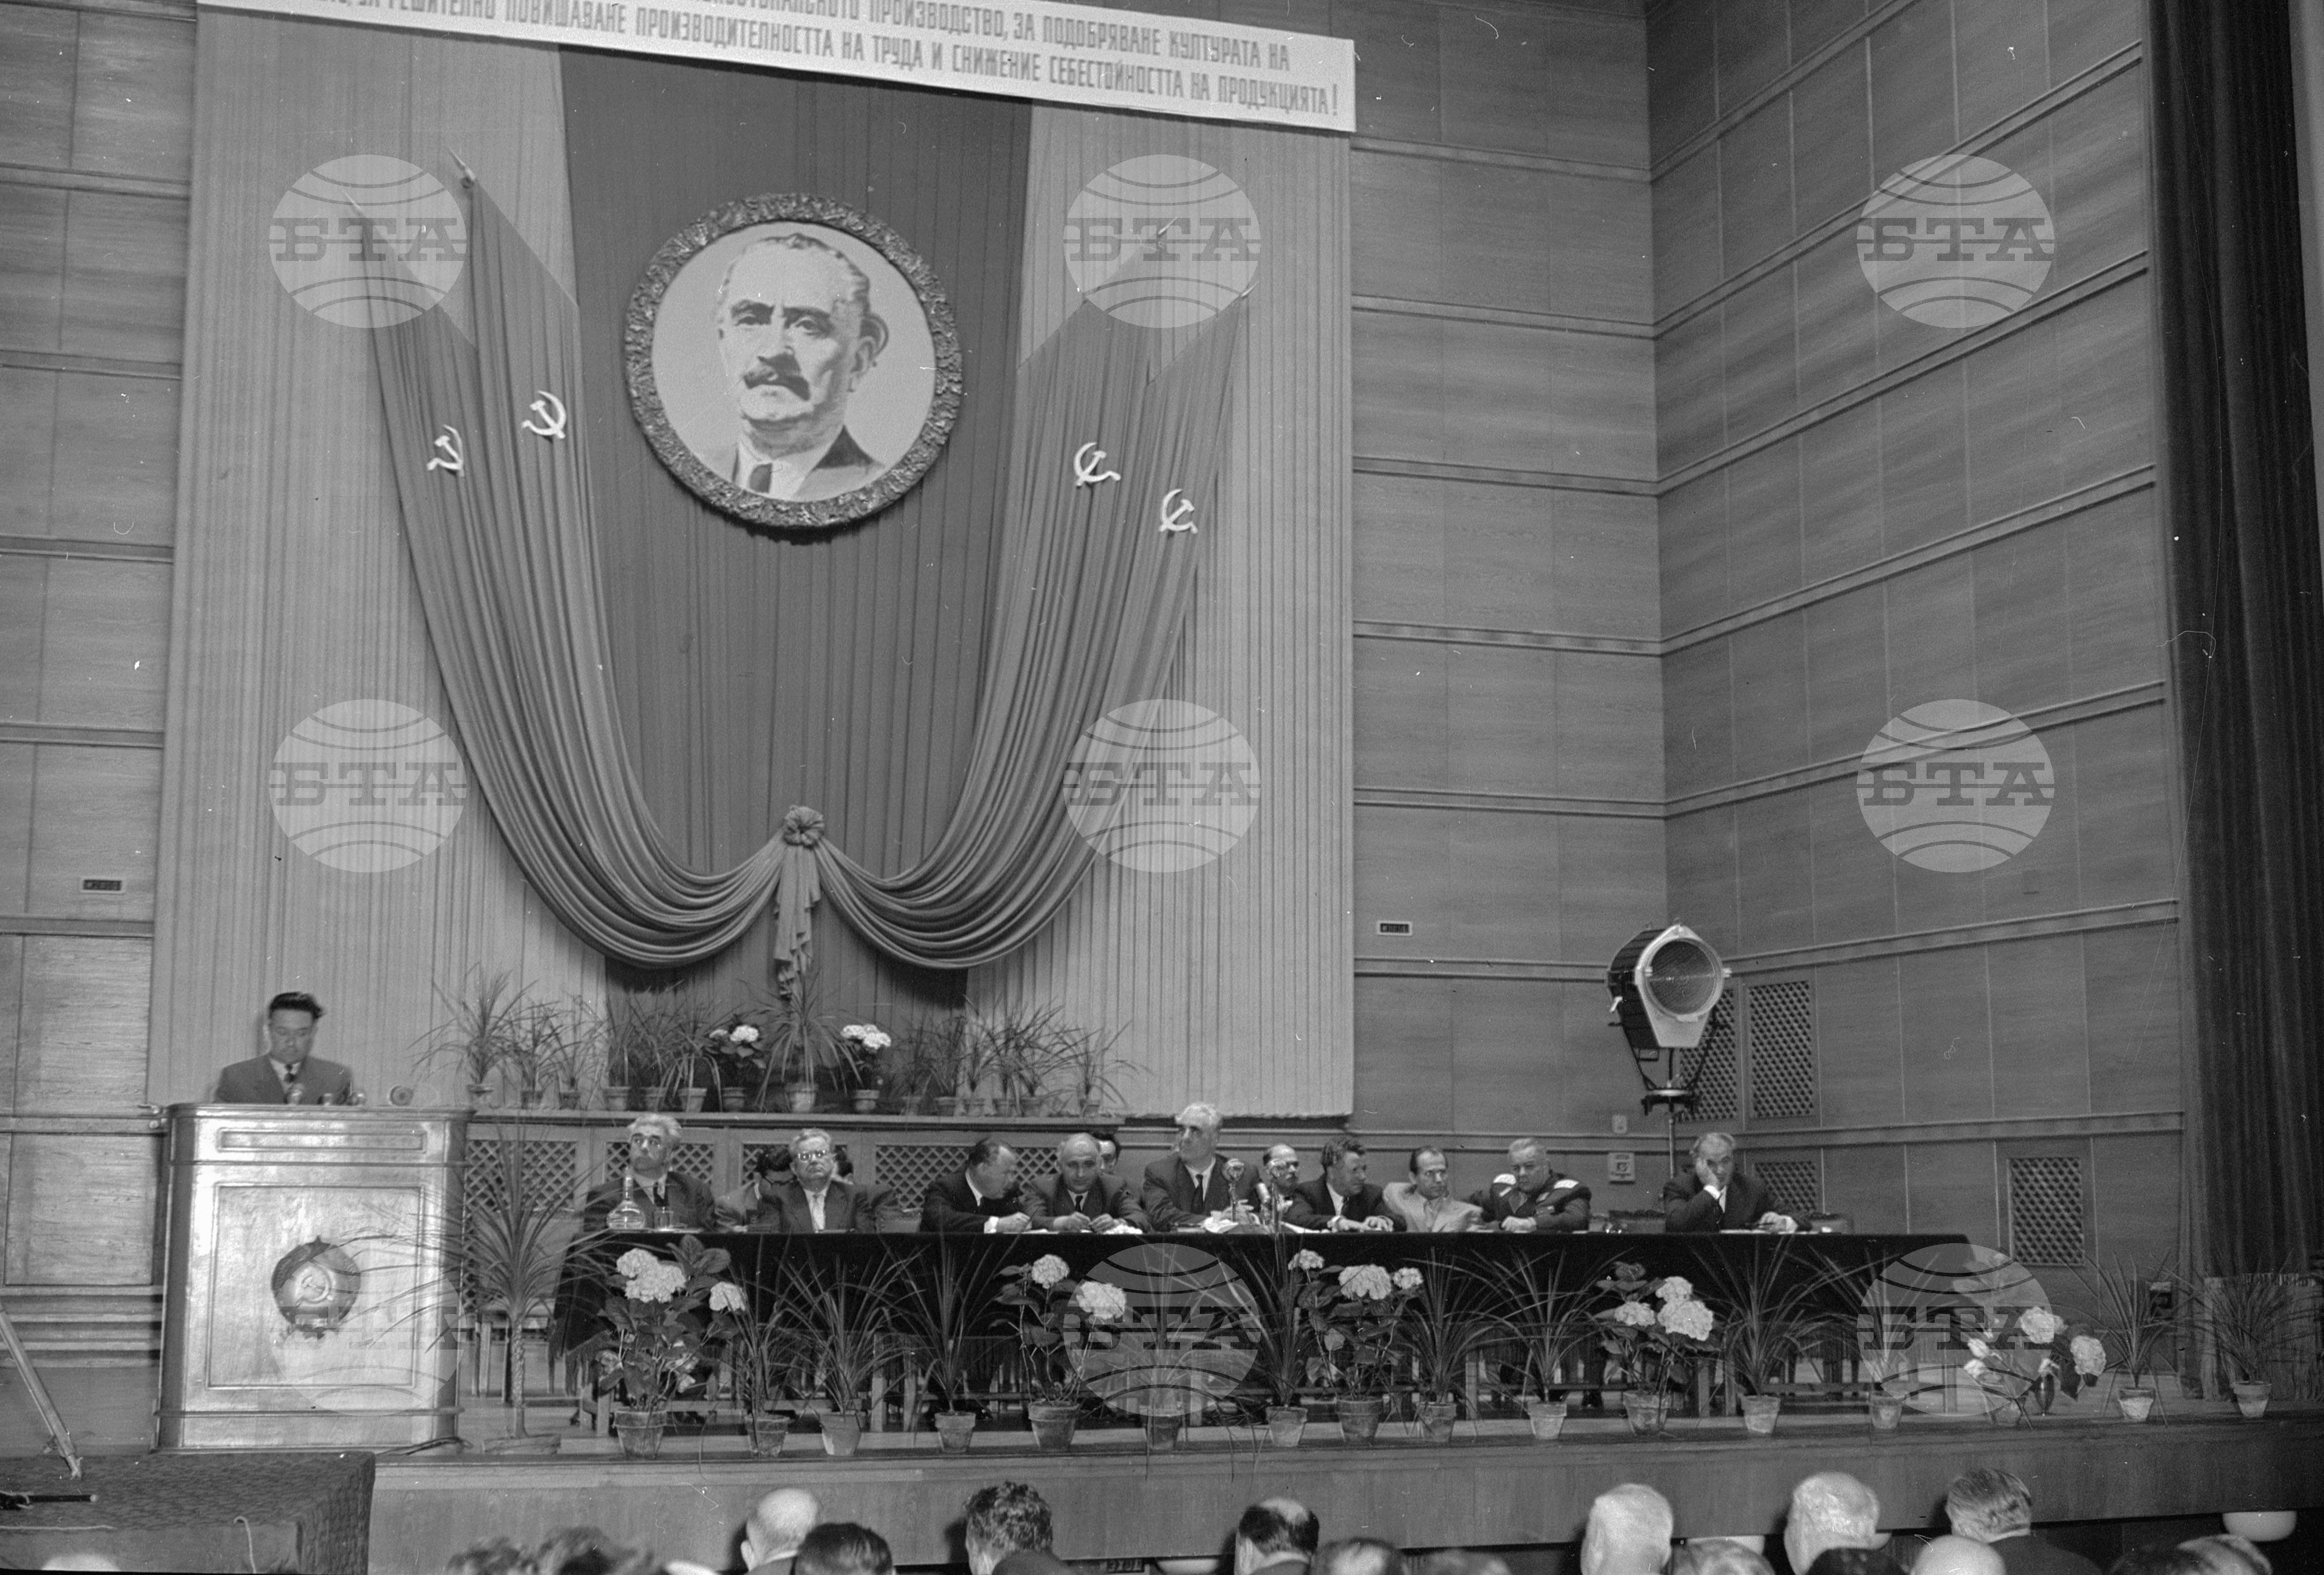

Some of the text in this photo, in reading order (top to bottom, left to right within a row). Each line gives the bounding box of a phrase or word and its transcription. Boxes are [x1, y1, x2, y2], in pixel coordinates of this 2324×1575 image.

[636, 8, 835, 57] ПРОИЗВОДИТЕЛНОСТТА
[841, 31, 865, 61] НА
[872, 35, 924, 71] ТРУДА
[931, 41, 943, 70] И
[952, 45, 1041, 81] СНИЖЕНИЕ
[1049, 56, 1184, 98] СЕБЕСТОЙНОСТТА
[1191, 72, 1210, 101] НА
[869, 0, 1009, 41] ПРОИЗВОДСТВО,
[1014, 12, 1036, 41] ЗА
[1043, 15, 1161, 56] ПОДОБРЯВАНЕ
[1168, 31, 1261, 69] КУЛТУРАТА
[1268, 43, 1290, 71] НА
